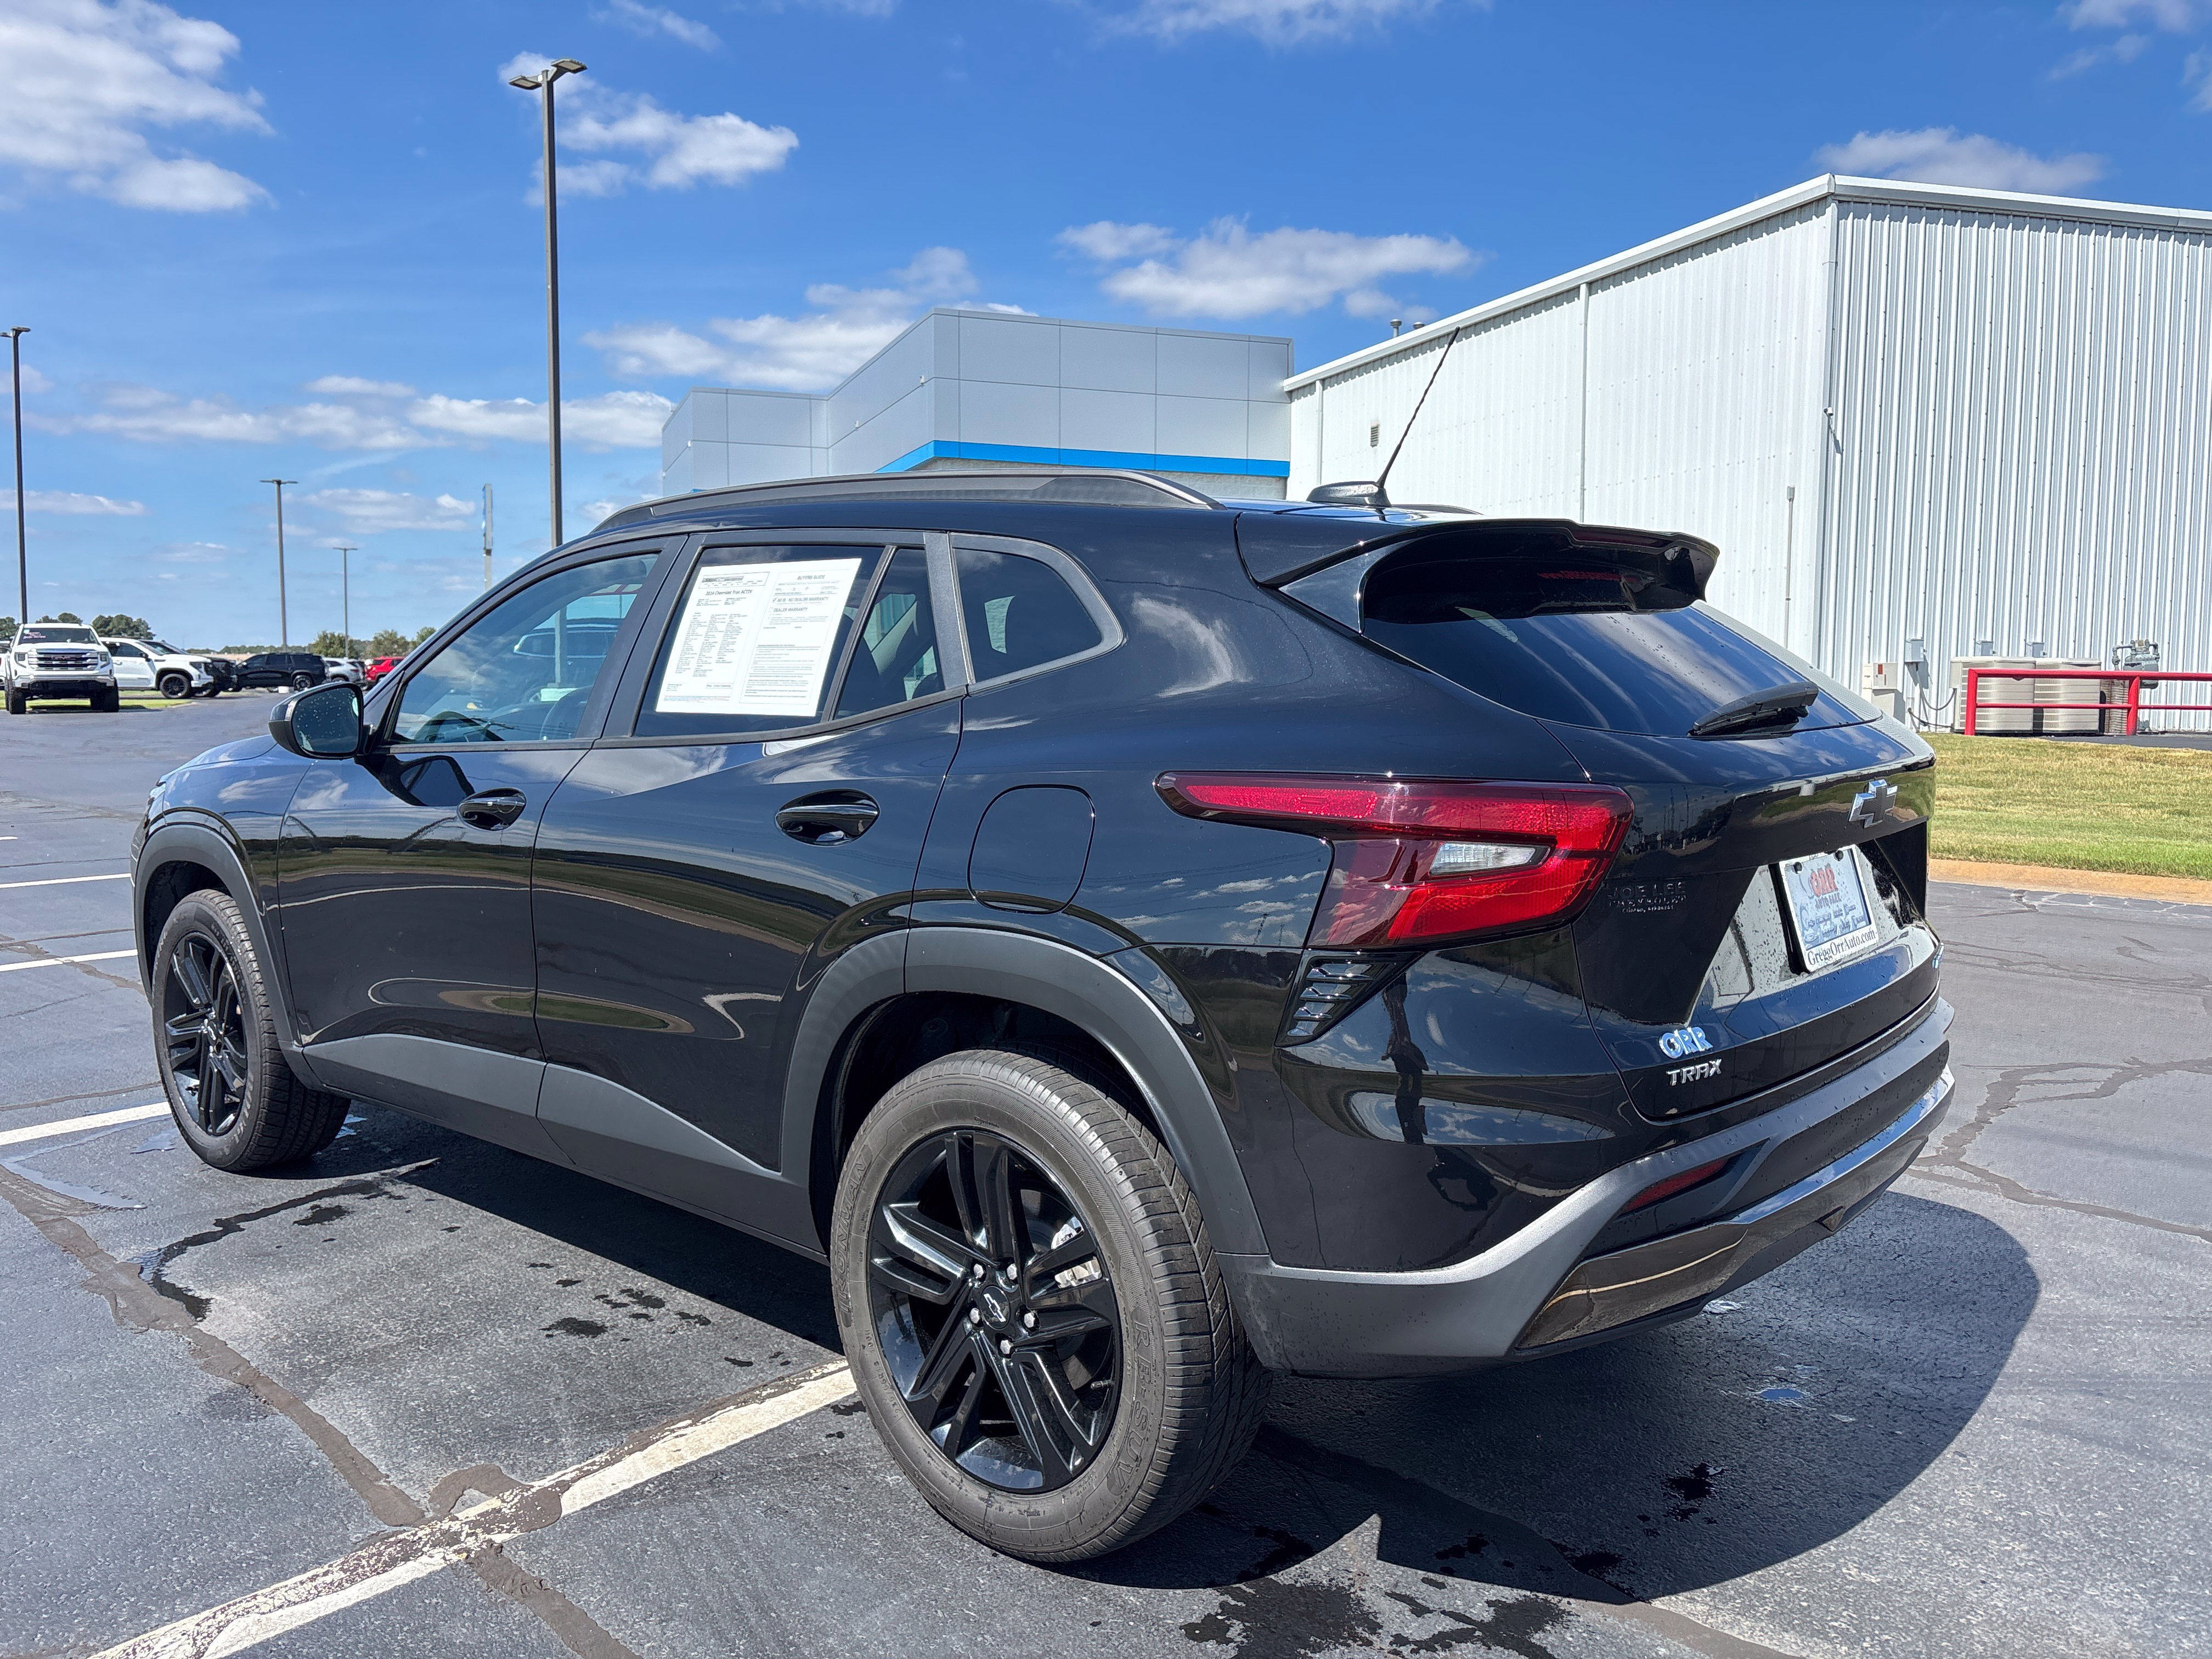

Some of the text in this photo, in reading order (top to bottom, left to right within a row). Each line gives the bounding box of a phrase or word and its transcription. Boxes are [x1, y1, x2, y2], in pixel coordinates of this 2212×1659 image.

[1809, 864, 1838, 898] ORR
[1807, 929, 1876, 966] GreggOrrAuto.com
[1659, 1027, 1713, 1059] ORR
[1666, 1058, 1722, 1086] TRAX
[837, 1152, 867, 1313] IRONMAN
